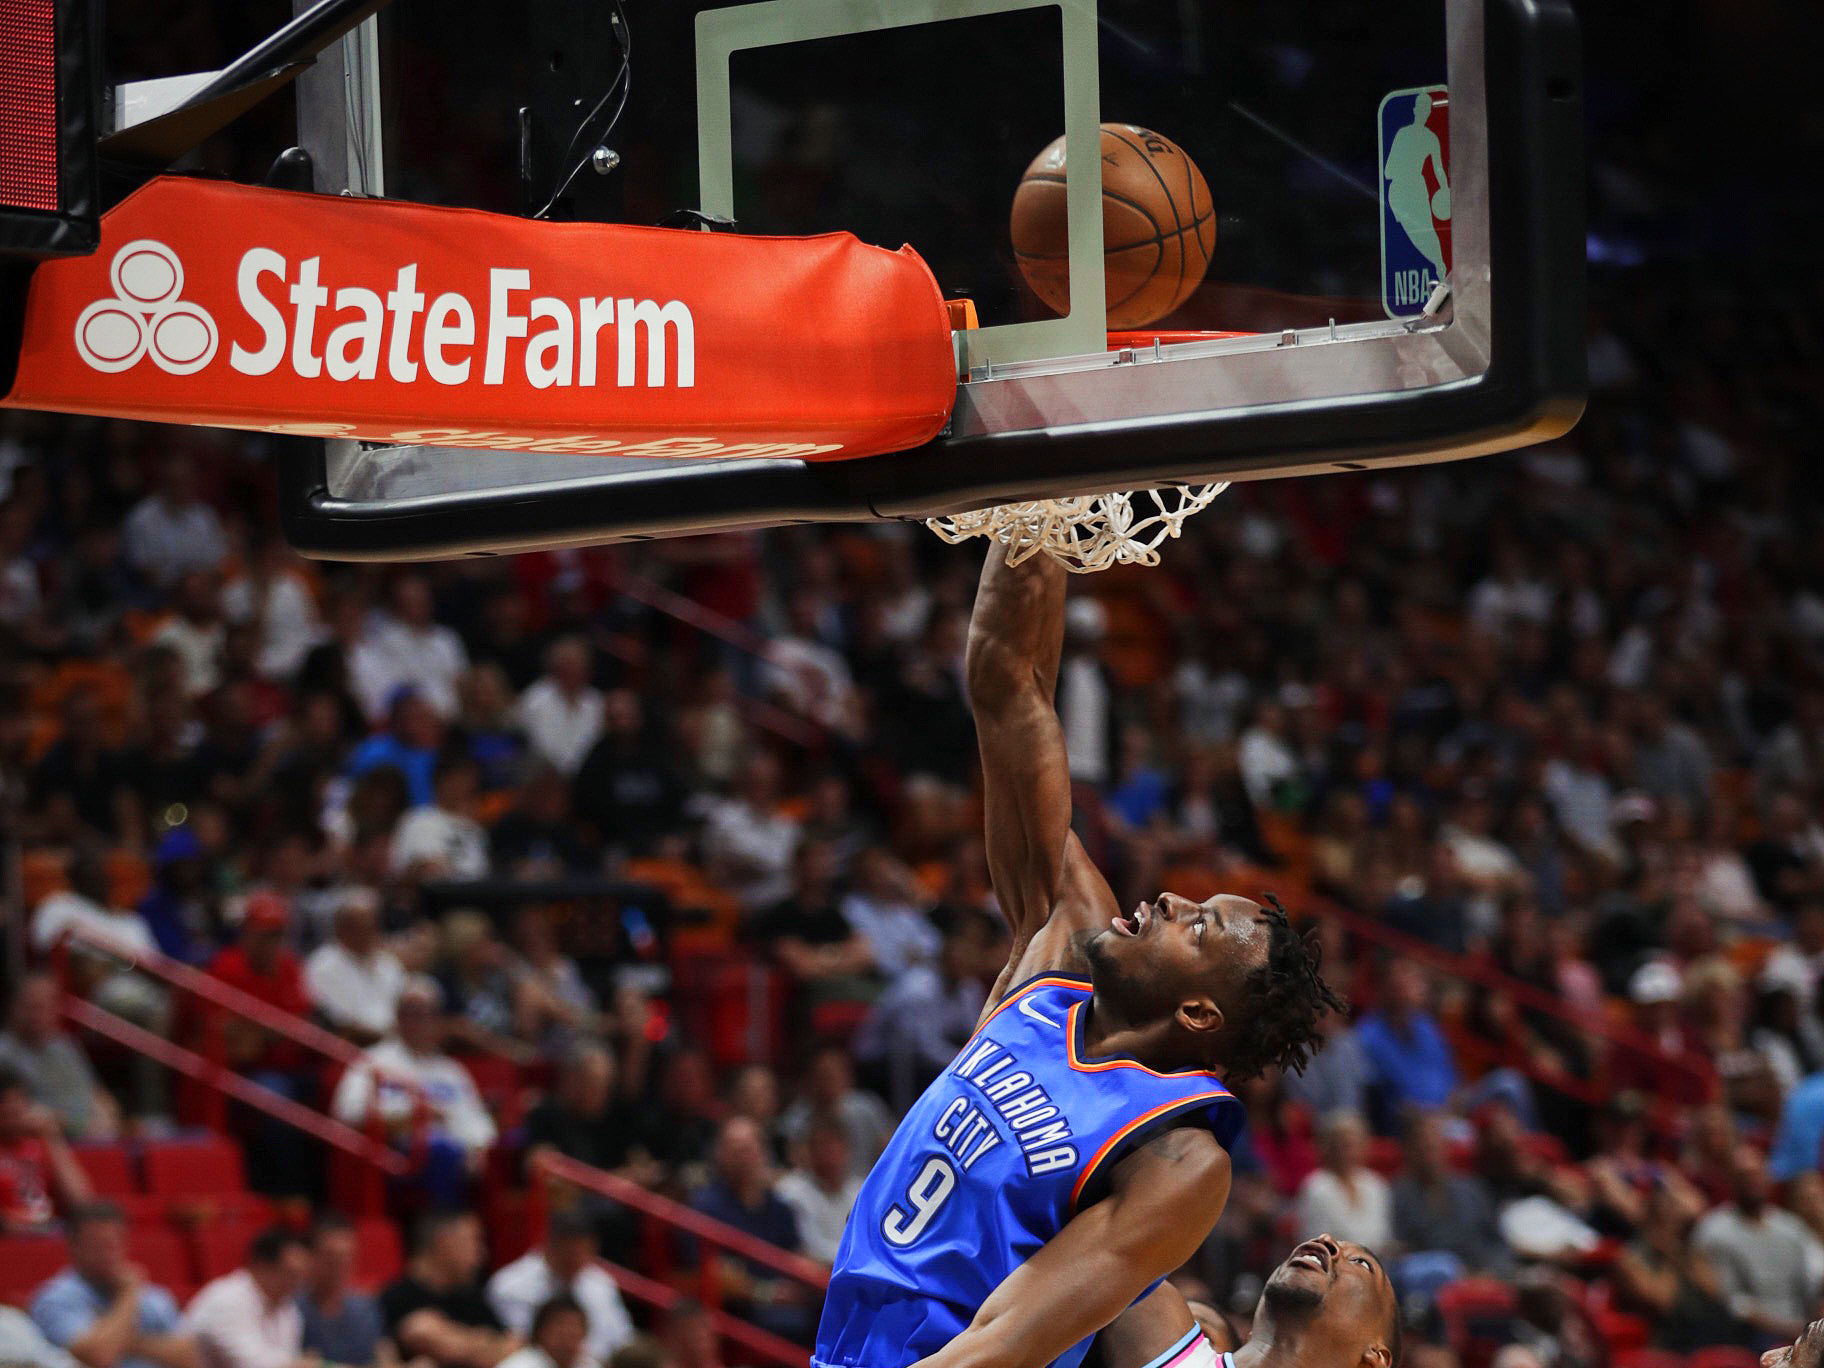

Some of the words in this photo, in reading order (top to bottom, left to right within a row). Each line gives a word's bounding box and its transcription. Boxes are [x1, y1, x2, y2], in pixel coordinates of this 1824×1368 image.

[1394, 267, 1431, 306] NBA
[933, 1095, 1005, 1175] CITY
[881, 1154, 958, 1248] 9
